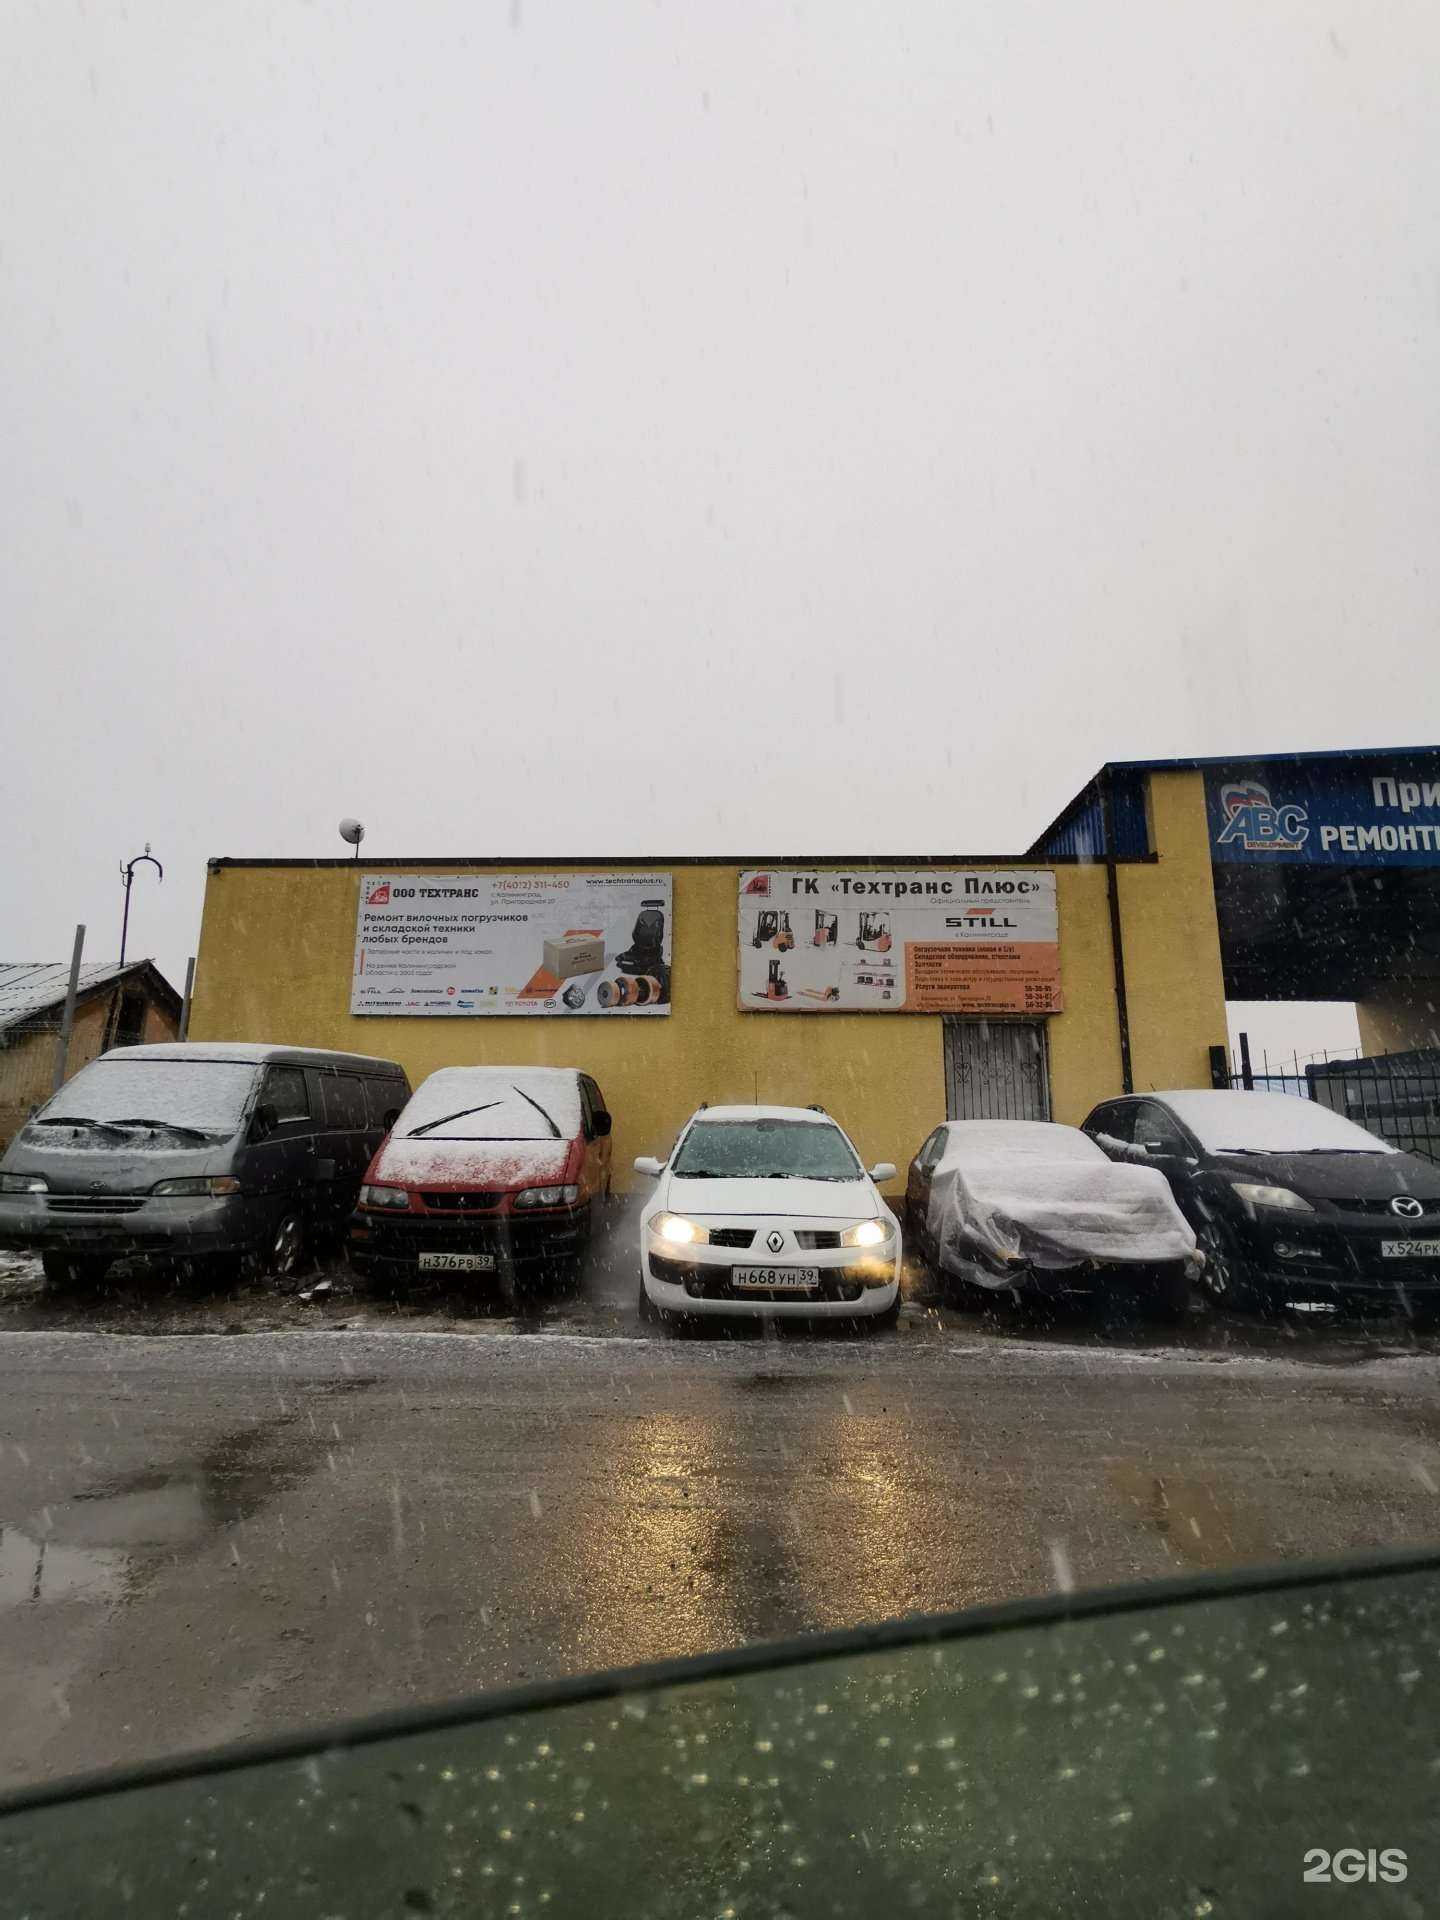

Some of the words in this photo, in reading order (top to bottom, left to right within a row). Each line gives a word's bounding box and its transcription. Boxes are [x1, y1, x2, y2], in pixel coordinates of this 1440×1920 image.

[1372, 776, 1440, 812] При
[1217, 804, 1309, 843] ABC
[1246, 841, 1300, 849] DEVELOPMENT
[792, 878, 819, 894] ГК
[831, 878, 953, 897] «Техтранс
[965, 877, 1040, 894] Плюс»
[393, 888, 415, 898] ООО
[419, 888, 479, 898] ТЕХТРАНС
[364, 913, 404, 922] Ремонт
[407, 914, 458, 922] вилочных
[461, 914, 528, 924] погрузчиков
[945, 917, 1017, 927] STILL
[372, 924, 430, 934] складской
[433, 925, 475, 933] техники
[362, 935, 398, 943] любых
[401, 934, 448, 945] брендов
[1387, 1241, 1439, 1255] Х524РК
[738, 1270, 796, 1284] Н668УН
[799, 1269, 814, 1281] 39
